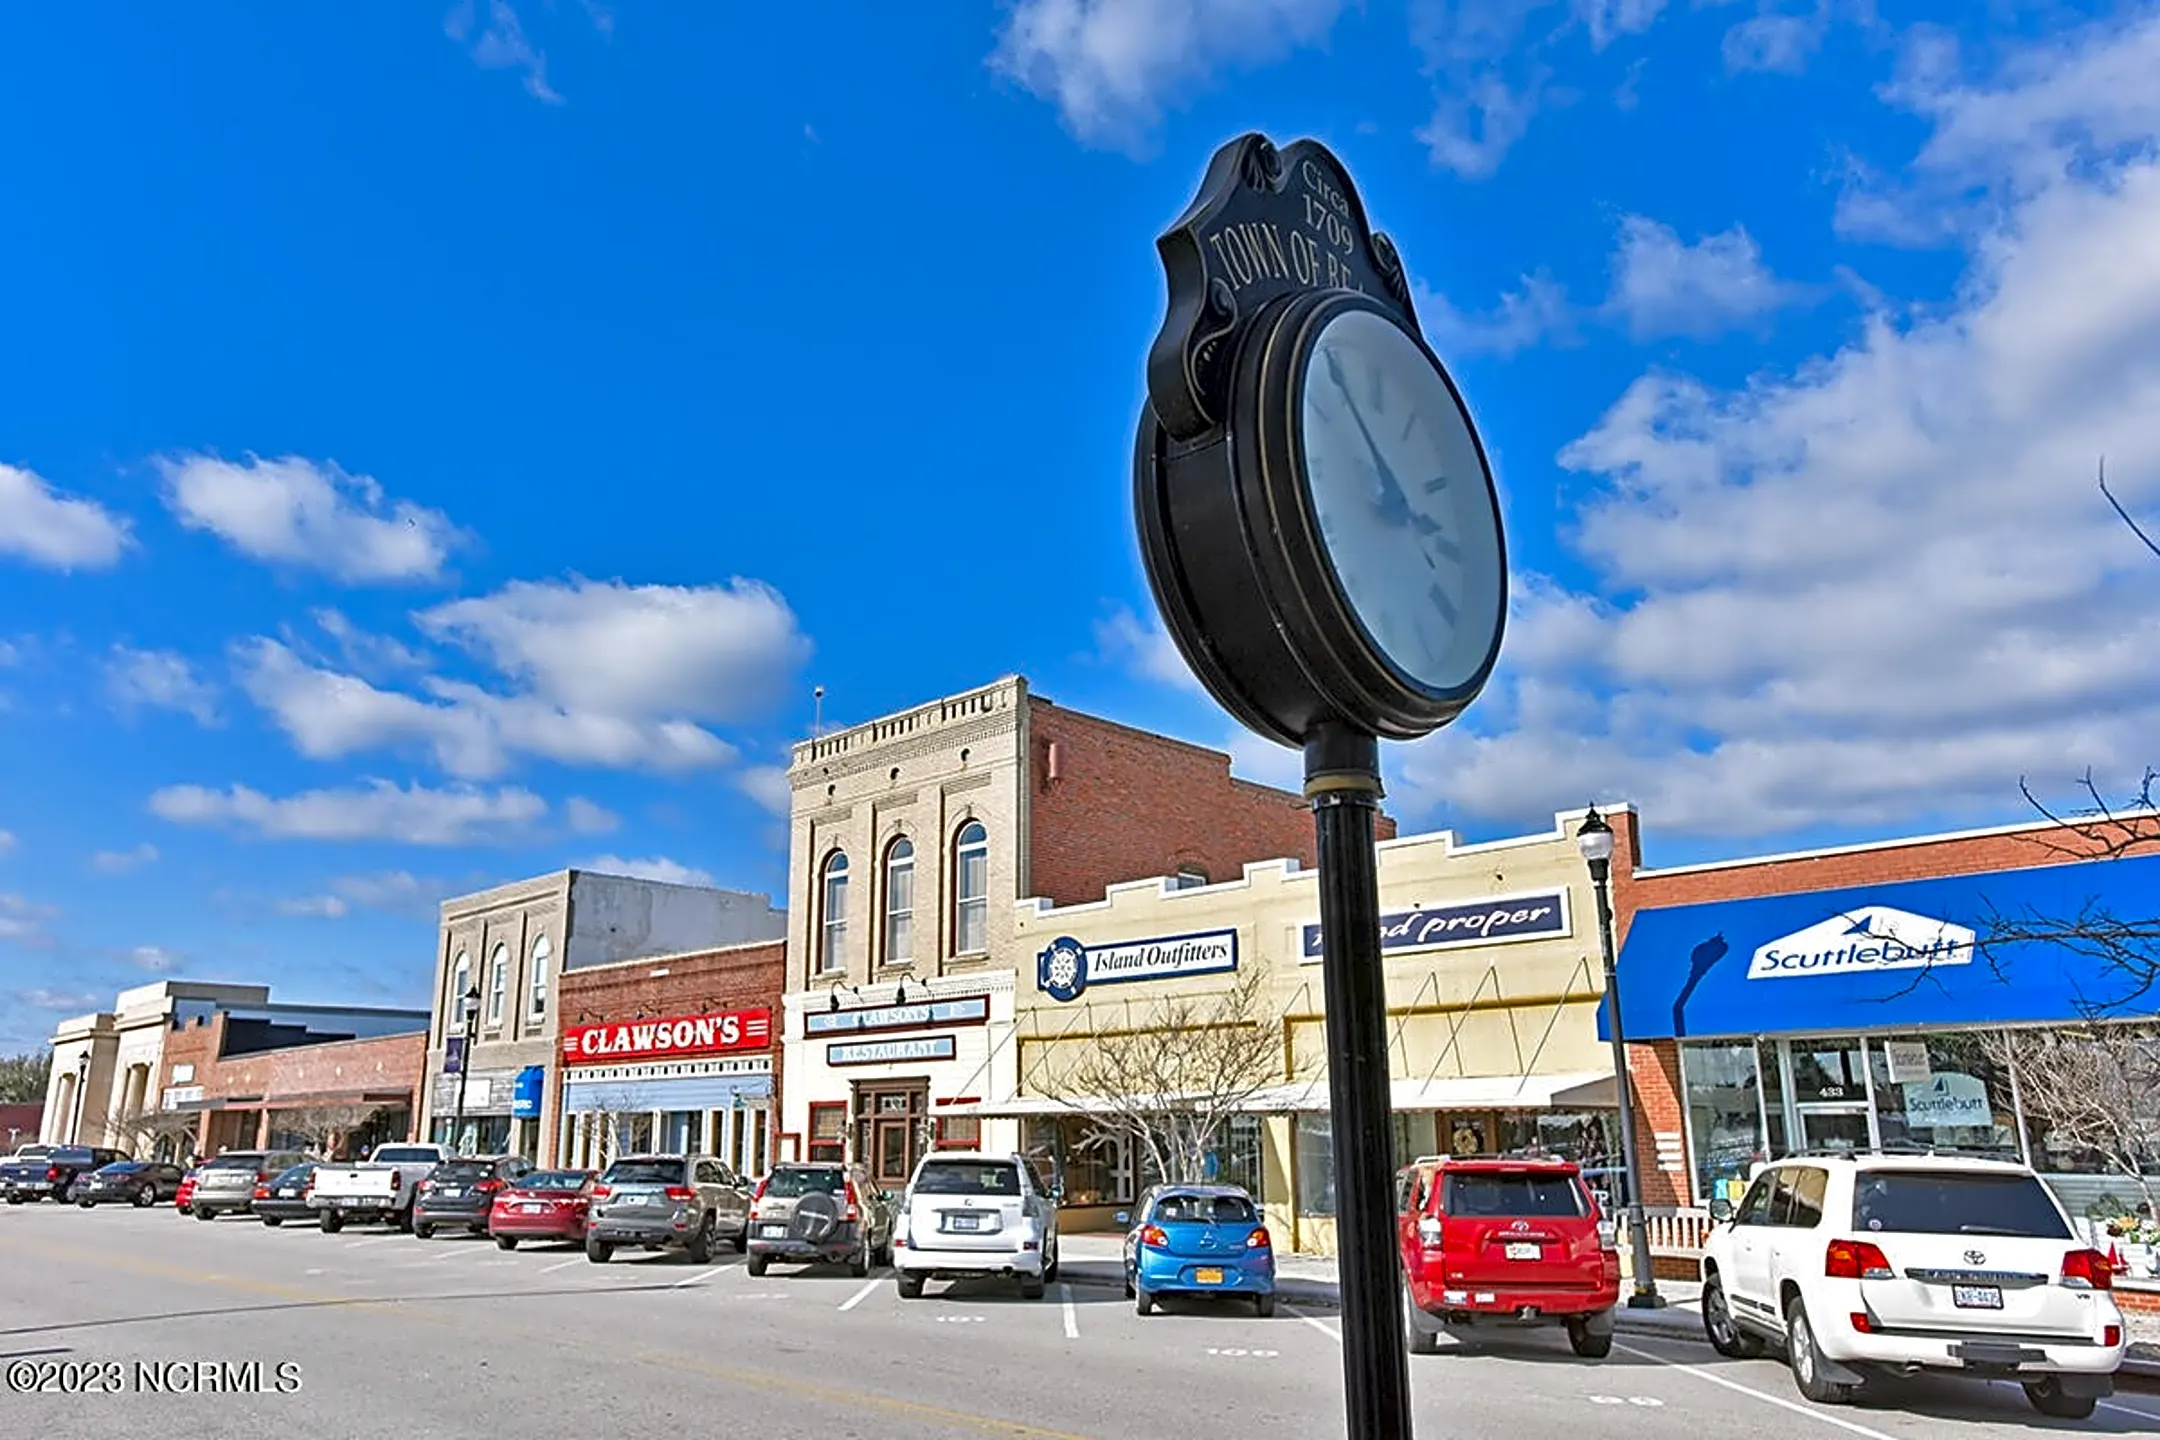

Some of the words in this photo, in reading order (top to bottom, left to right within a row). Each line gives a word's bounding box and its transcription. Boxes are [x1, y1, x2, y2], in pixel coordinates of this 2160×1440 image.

[1302, 160, 1350, 219] Circa
[1302, 193, 1355, 255] 1709
[1209, 222, 1290, 291] TOWN
[1290, 230, 1320, 287] OF
[1417, 905, 1551, 943] proper
[1094, 947, 1145, 972] Island
[1147, 942, 1229, 968] Outfitters
[1760, 938, 1960, 972] Scuttlebutt
[581, 1015, 740, 1054] CLAWSON'S
[842, 1041, 938, 1062] RESTAURANT
[1819, 1087, 1844, 1097] 433
